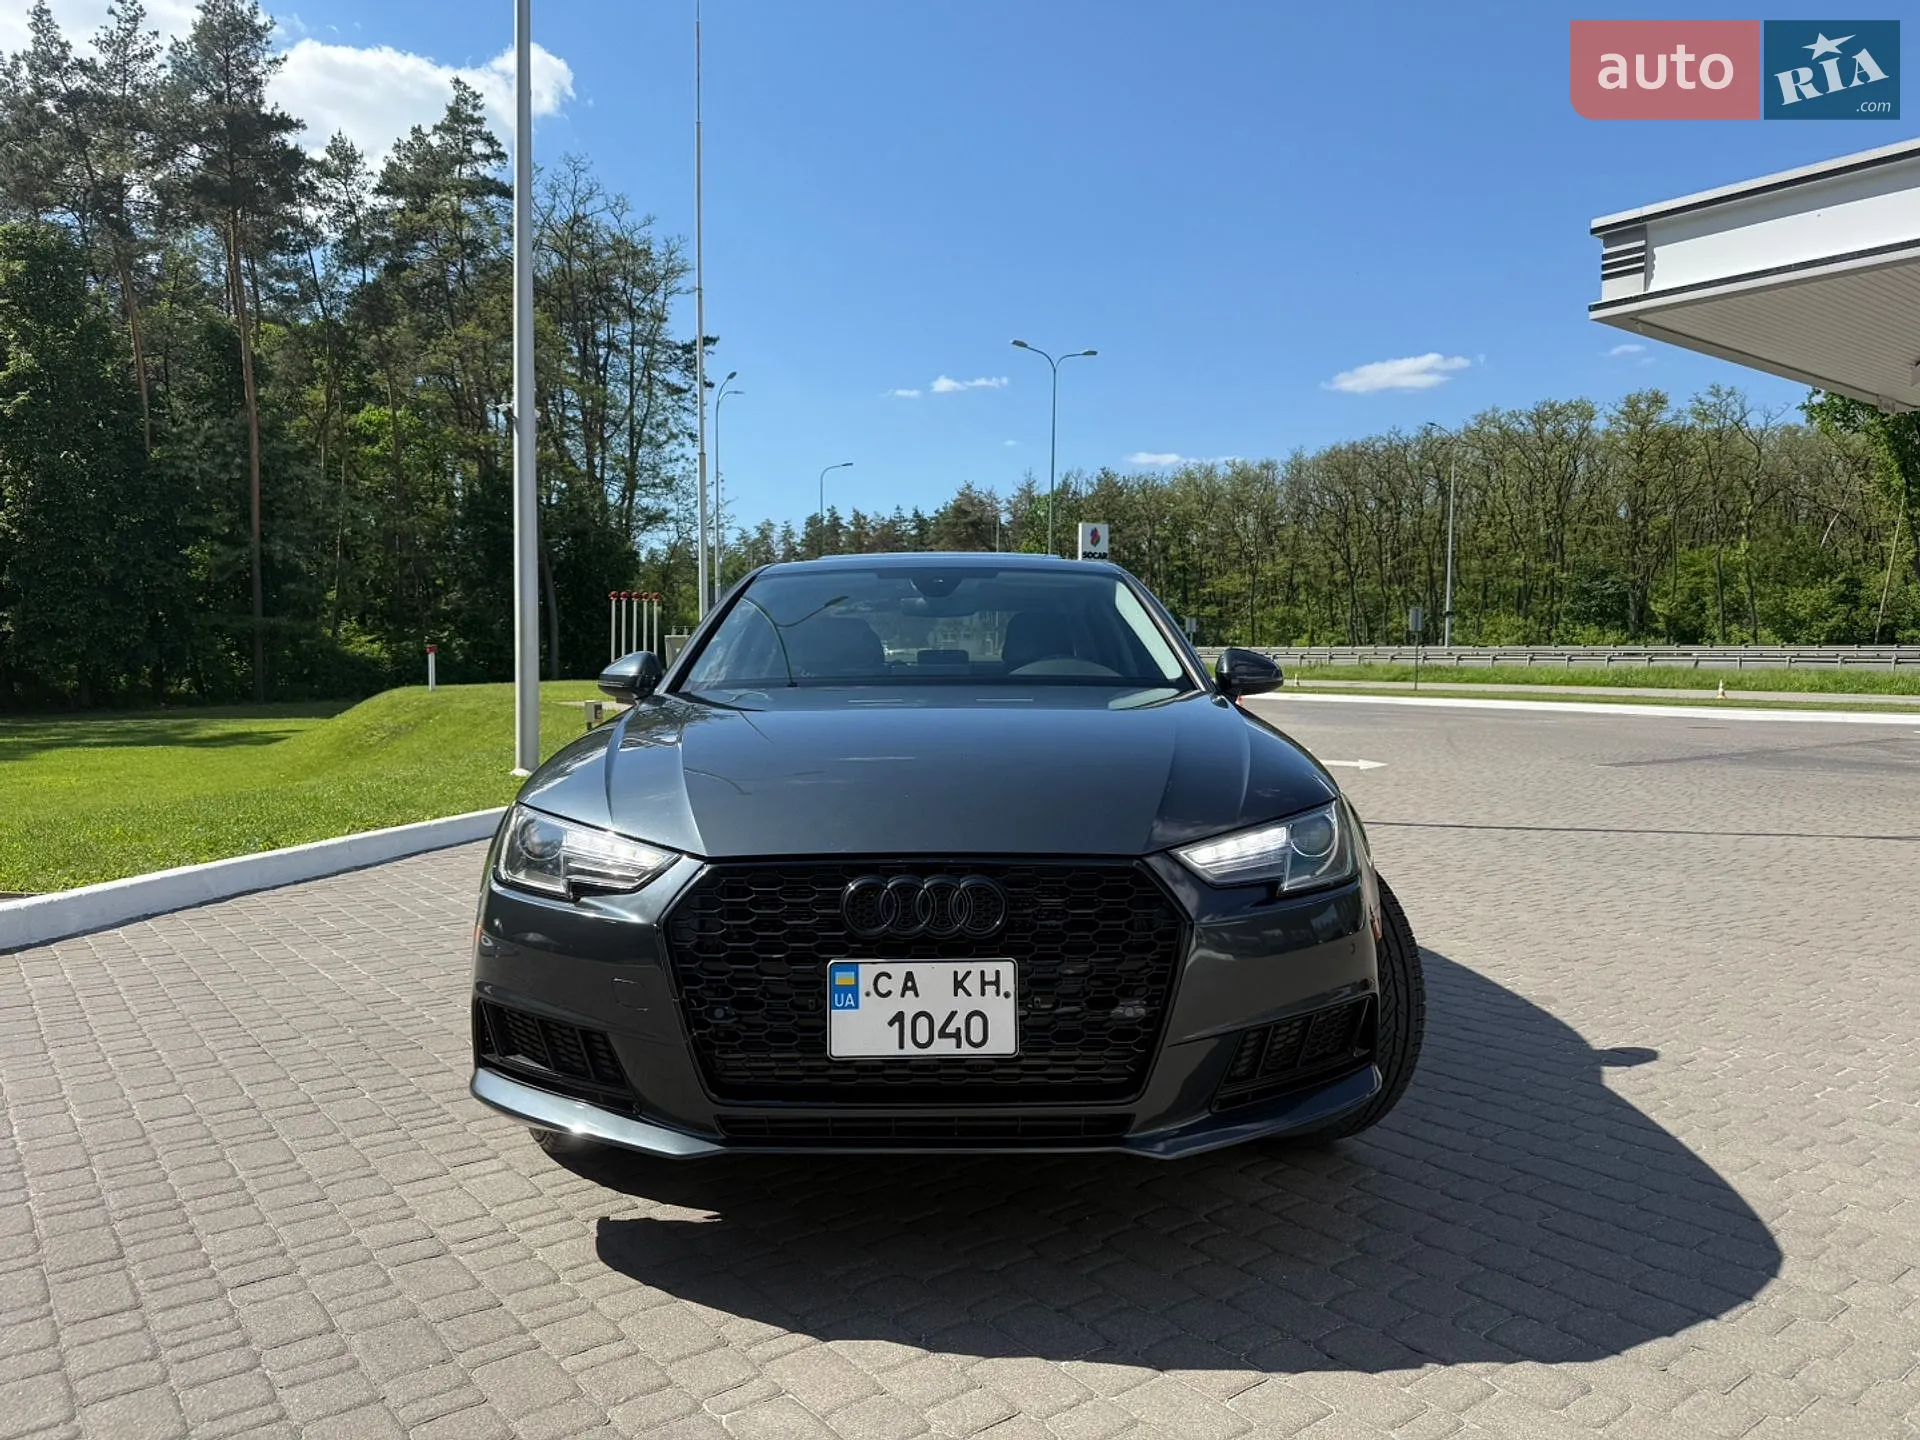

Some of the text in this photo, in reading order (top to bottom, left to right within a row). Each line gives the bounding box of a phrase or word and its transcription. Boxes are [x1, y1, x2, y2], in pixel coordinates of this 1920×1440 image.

[1082, 551, 1108, 560] SOCAR
[834, 993, 855, 1008] UA
[887, 1009, 989, 1050] 1040
